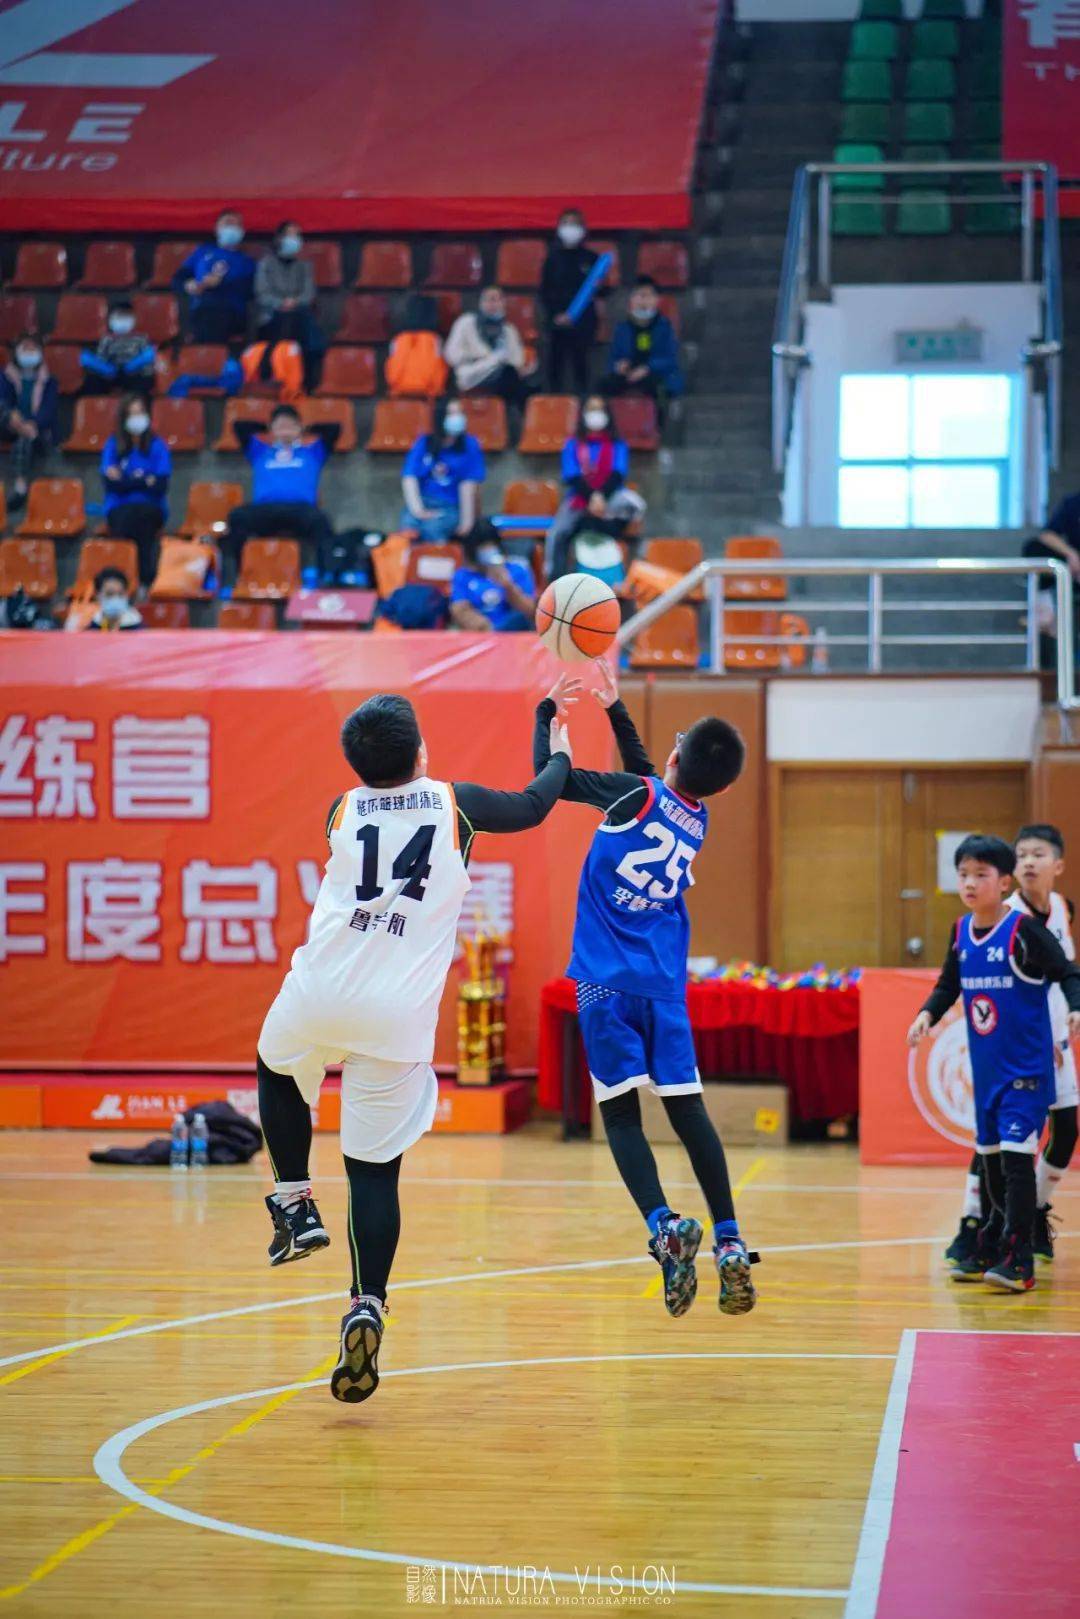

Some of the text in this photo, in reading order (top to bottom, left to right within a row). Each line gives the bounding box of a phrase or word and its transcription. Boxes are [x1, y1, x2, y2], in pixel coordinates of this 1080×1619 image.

[355, 823, 437, 902] 14
[615, 822, 697, 900] 25
[986, 946, 1004, 962] 24
